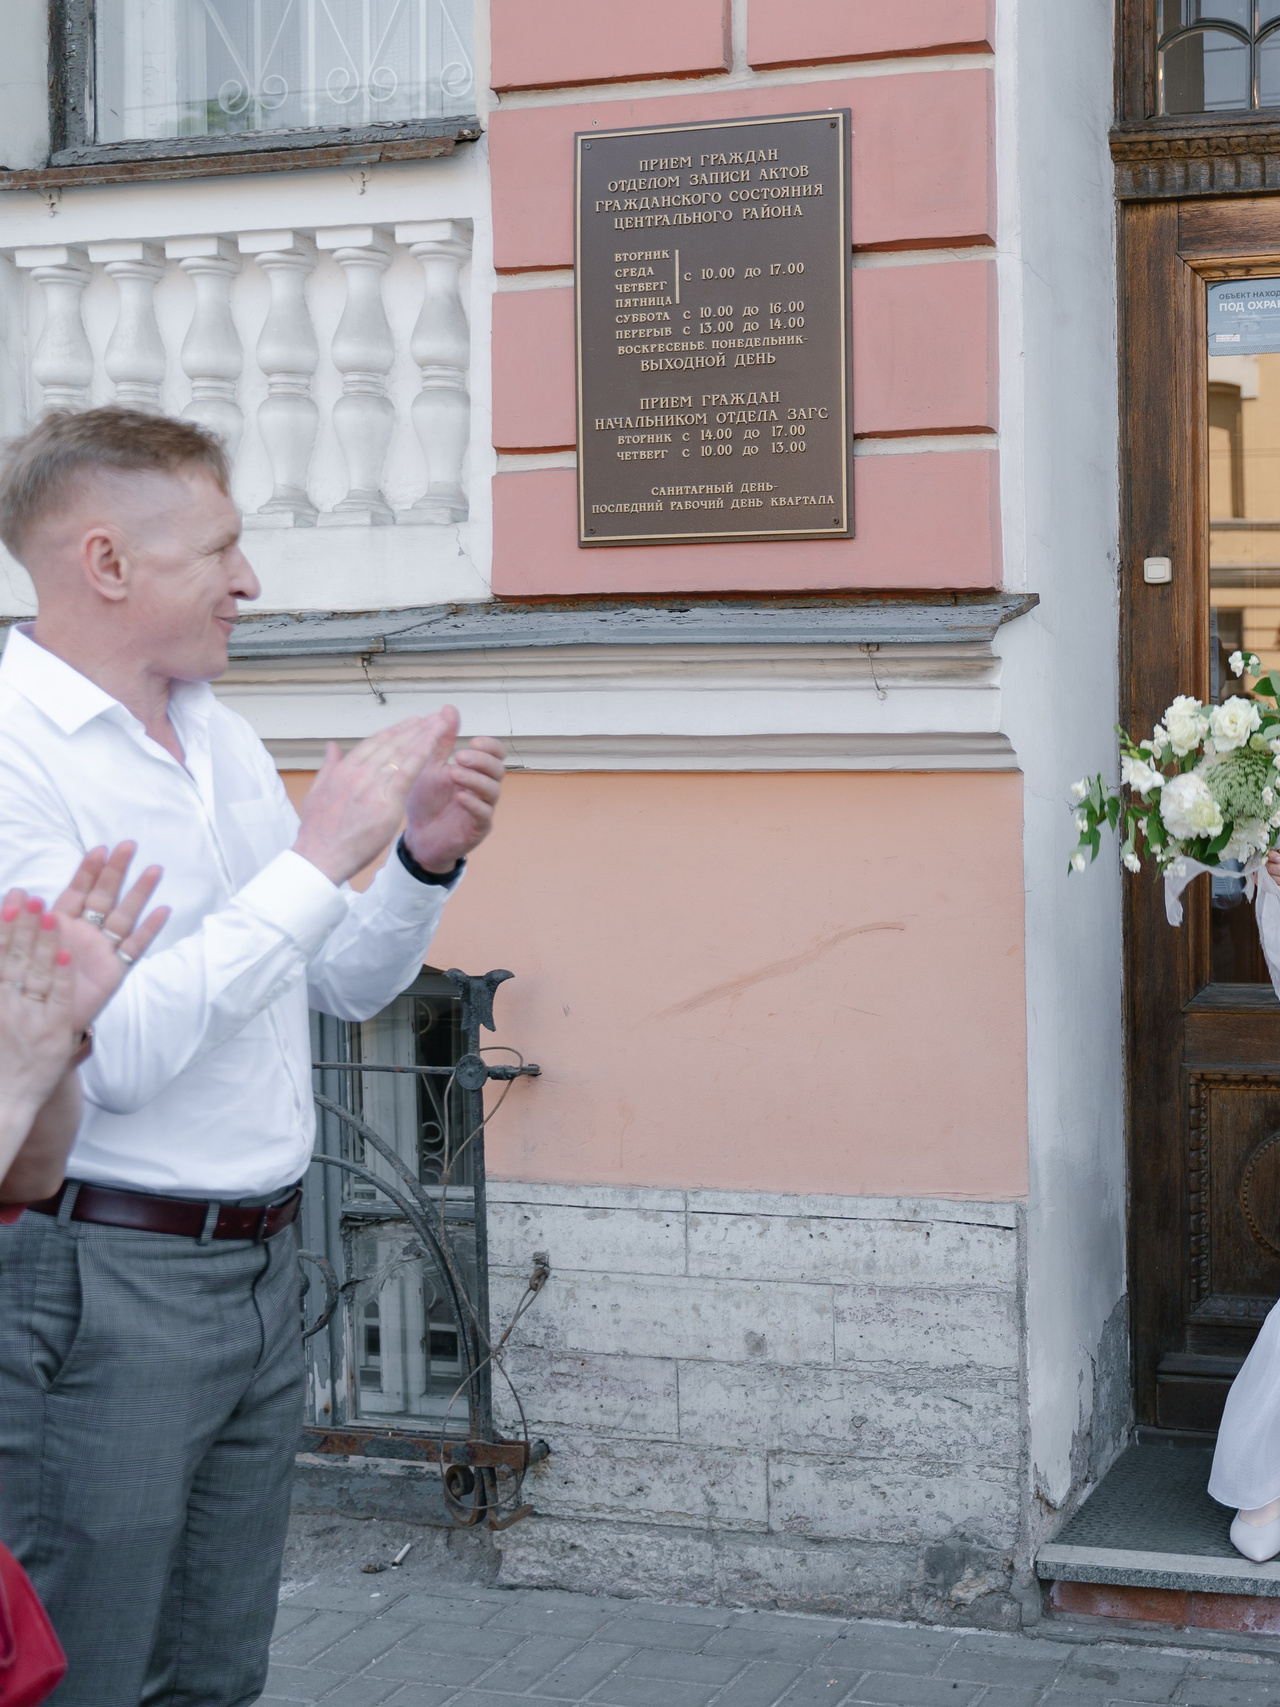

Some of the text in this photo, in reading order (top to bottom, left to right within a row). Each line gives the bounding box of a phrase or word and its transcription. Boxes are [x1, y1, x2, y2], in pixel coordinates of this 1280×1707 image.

[640, 149, 778, 172] ПРИЕМ ГРАЖДАН
[608, 166, 809, 193] ОТДЕЛОМ ЗАПИСИ АКТОВ
[595, 184, 824, 212] ГРАЖДАНСКОГО СОСТОЯНИЯ
[614, 204, 803, 231] ЦЕНТРАЛЬНОГО РАЙОНА
[615, 250, 670, 262] ВТОРНИК
[615, 267, 654, 278] СРЕДА
[701, 268, 735, 280] 10.00
[770, 262, 805, 275] 17.00
[615, 281, 667, 293] ЧЕТВЕРГ
[616, 297, 672, 308] ПЯТНИЦА
[616, 312, 670, 324] СУББОТА
[700, 306, 733, 318] 10.00
[769, 301, 805, 313] 16.00
[1219, 302, 1244, 312] ПОД
[616, 327, 672, 339] ПЕРЕРЫВ
[700, 322, 734, 334] 13.00
[769, 317, 805, 329] 14.00
[641, 352, 776, 372] ВЫХОДНОЙ ДЕНЬ
[640, 391, 781, 411] ПРИЕМ ГРАЖДАН
[595, 408, 829, 431] НАЧАЛЬНИКОМ ОТДЕЛА ЗАГС
[618, 433, 672, 445] ВТОРНИК
[701, 429, 732, 441] 14.00
[772, 425, 806, 437] 17.00
[617, 450, 668, 461] ЧЕТВЕРГ
[701, 445, 732, 457] 10.00
[771, 441, 806, 454] 13.00
[651, 482, 734, 496] САНИТАРНЫЙ
[592, 495, 835, 514] ПОСЛЕДНИЙ РАБОЧИЙ ДЕНЬ КВАРТАЛА
